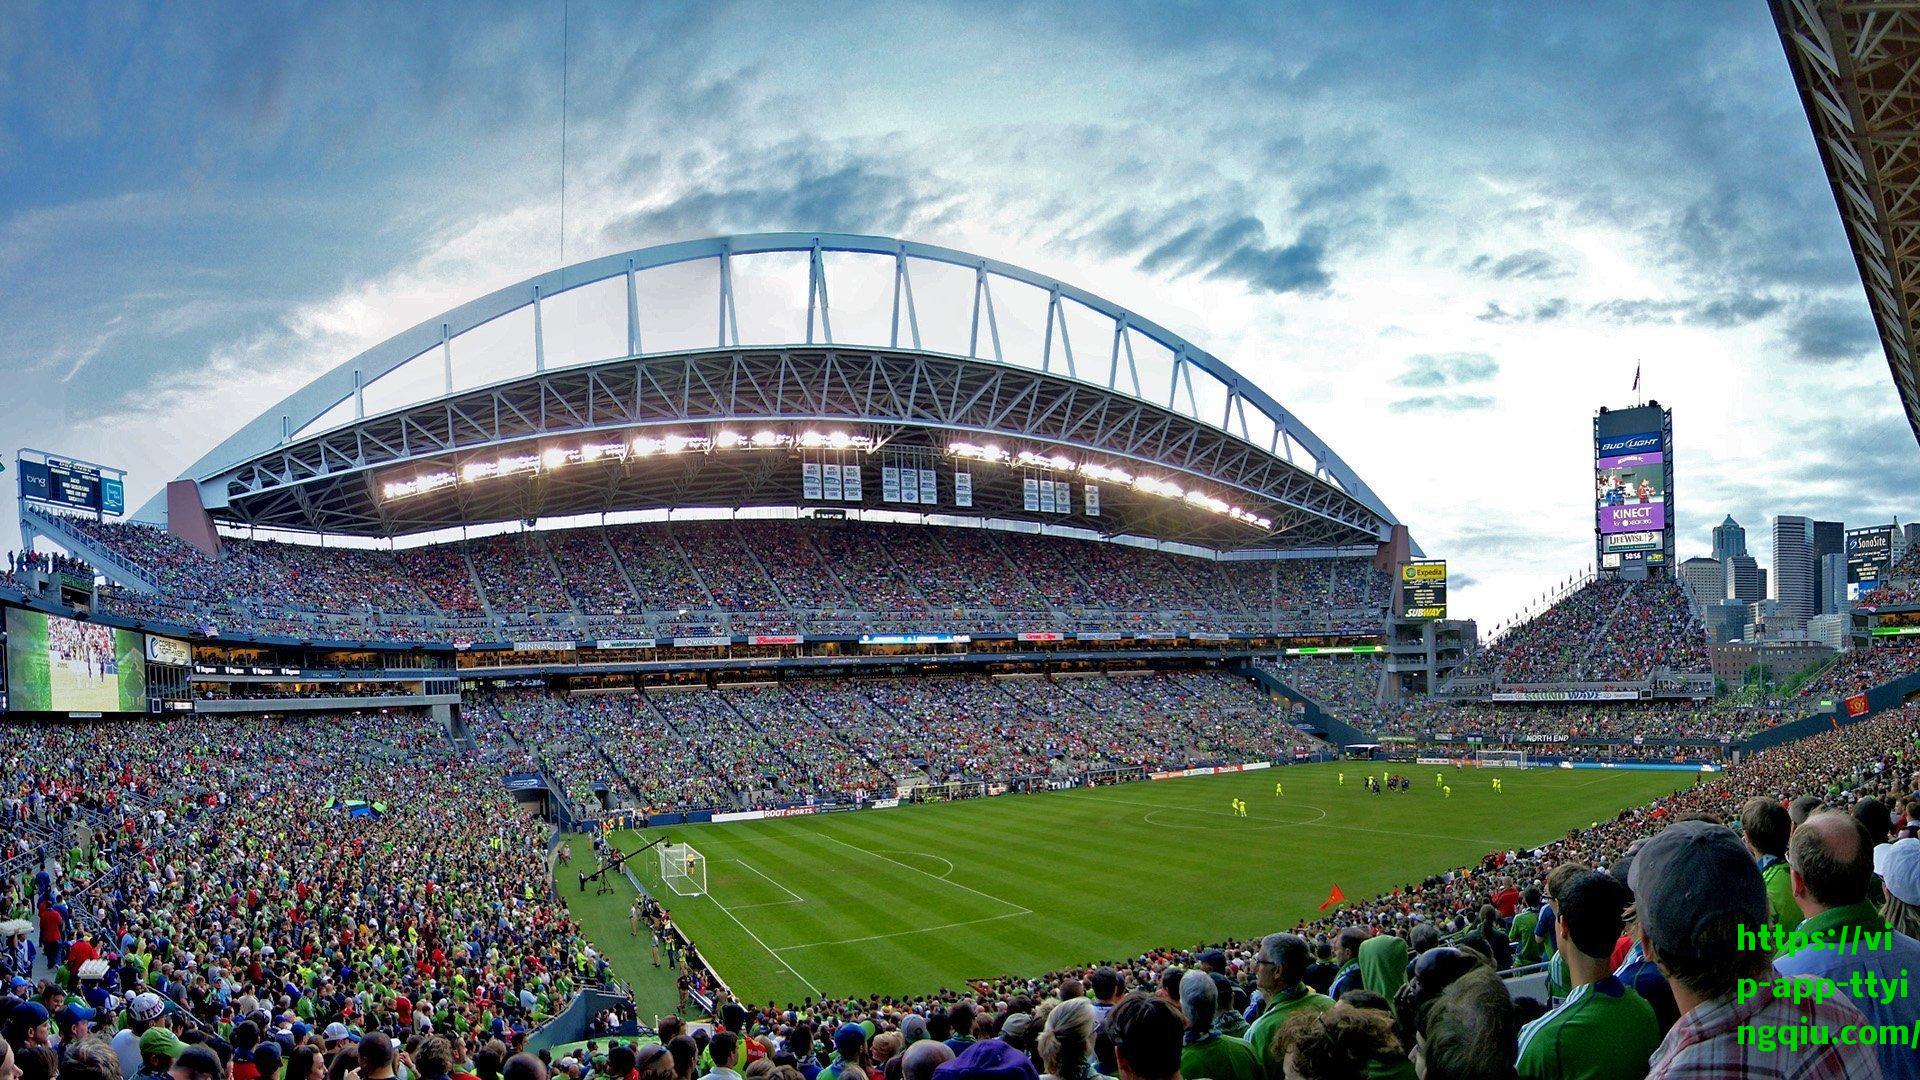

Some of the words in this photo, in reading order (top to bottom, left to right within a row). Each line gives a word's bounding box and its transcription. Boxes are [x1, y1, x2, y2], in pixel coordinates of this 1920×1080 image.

[1602, 442, 1624, 451] BUD
[1628, 438, 1659, 448] LIGHT
[26, 474, 46, 488] bing
[1613, 506, 1653, 519] KINECT
[1858, 536, 1886, 548] SonoSite
[1417, 567, 1442, 577] Expedia
[1405, 607, 1445, 618] SUBWAY
[1526, 734, 1552, 743] NORTH
[1553, 734, 1569, 742] END
[764, 808, 785, 818] ROOT
[786, 807, 813, 816] SPORTS
